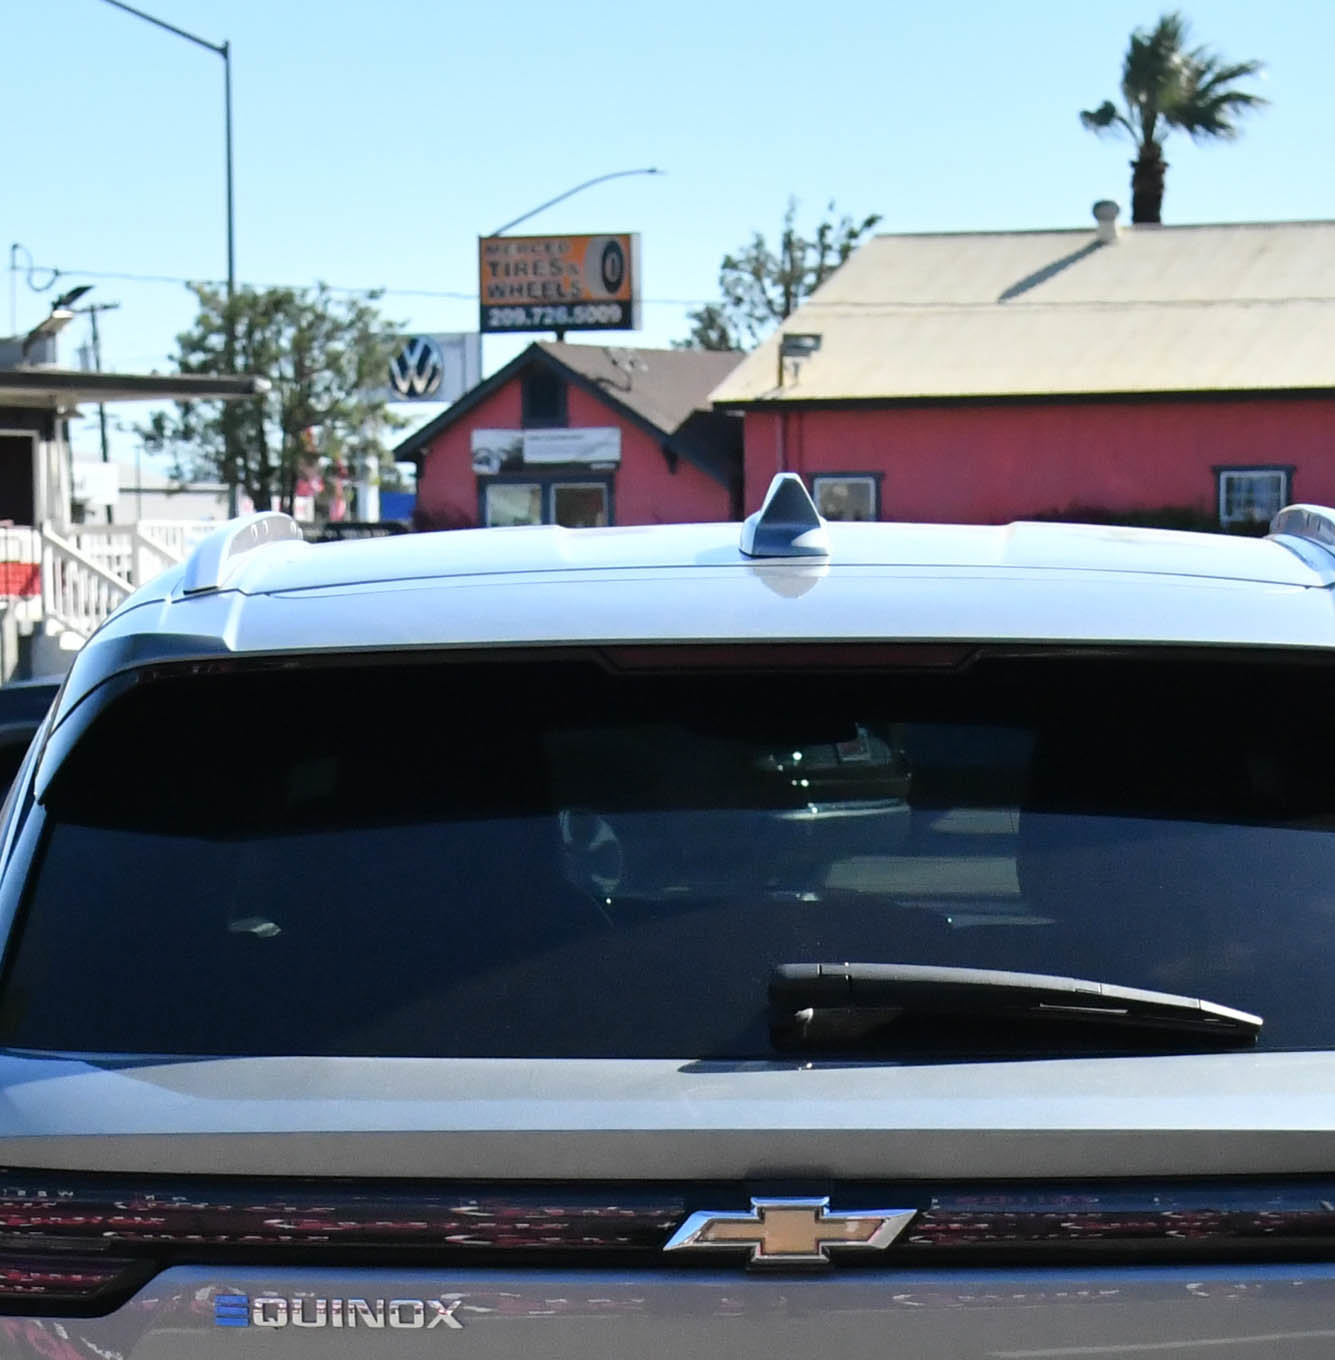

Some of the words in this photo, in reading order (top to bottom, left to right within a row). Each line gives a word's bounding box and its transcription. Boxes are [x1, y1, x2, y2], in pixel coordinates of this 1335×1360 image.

[488, 258, 563, 277] TIRES
[487, 280, 581, 298] WHEELS
[215, 1294, 464, 1329] EQUINOX
